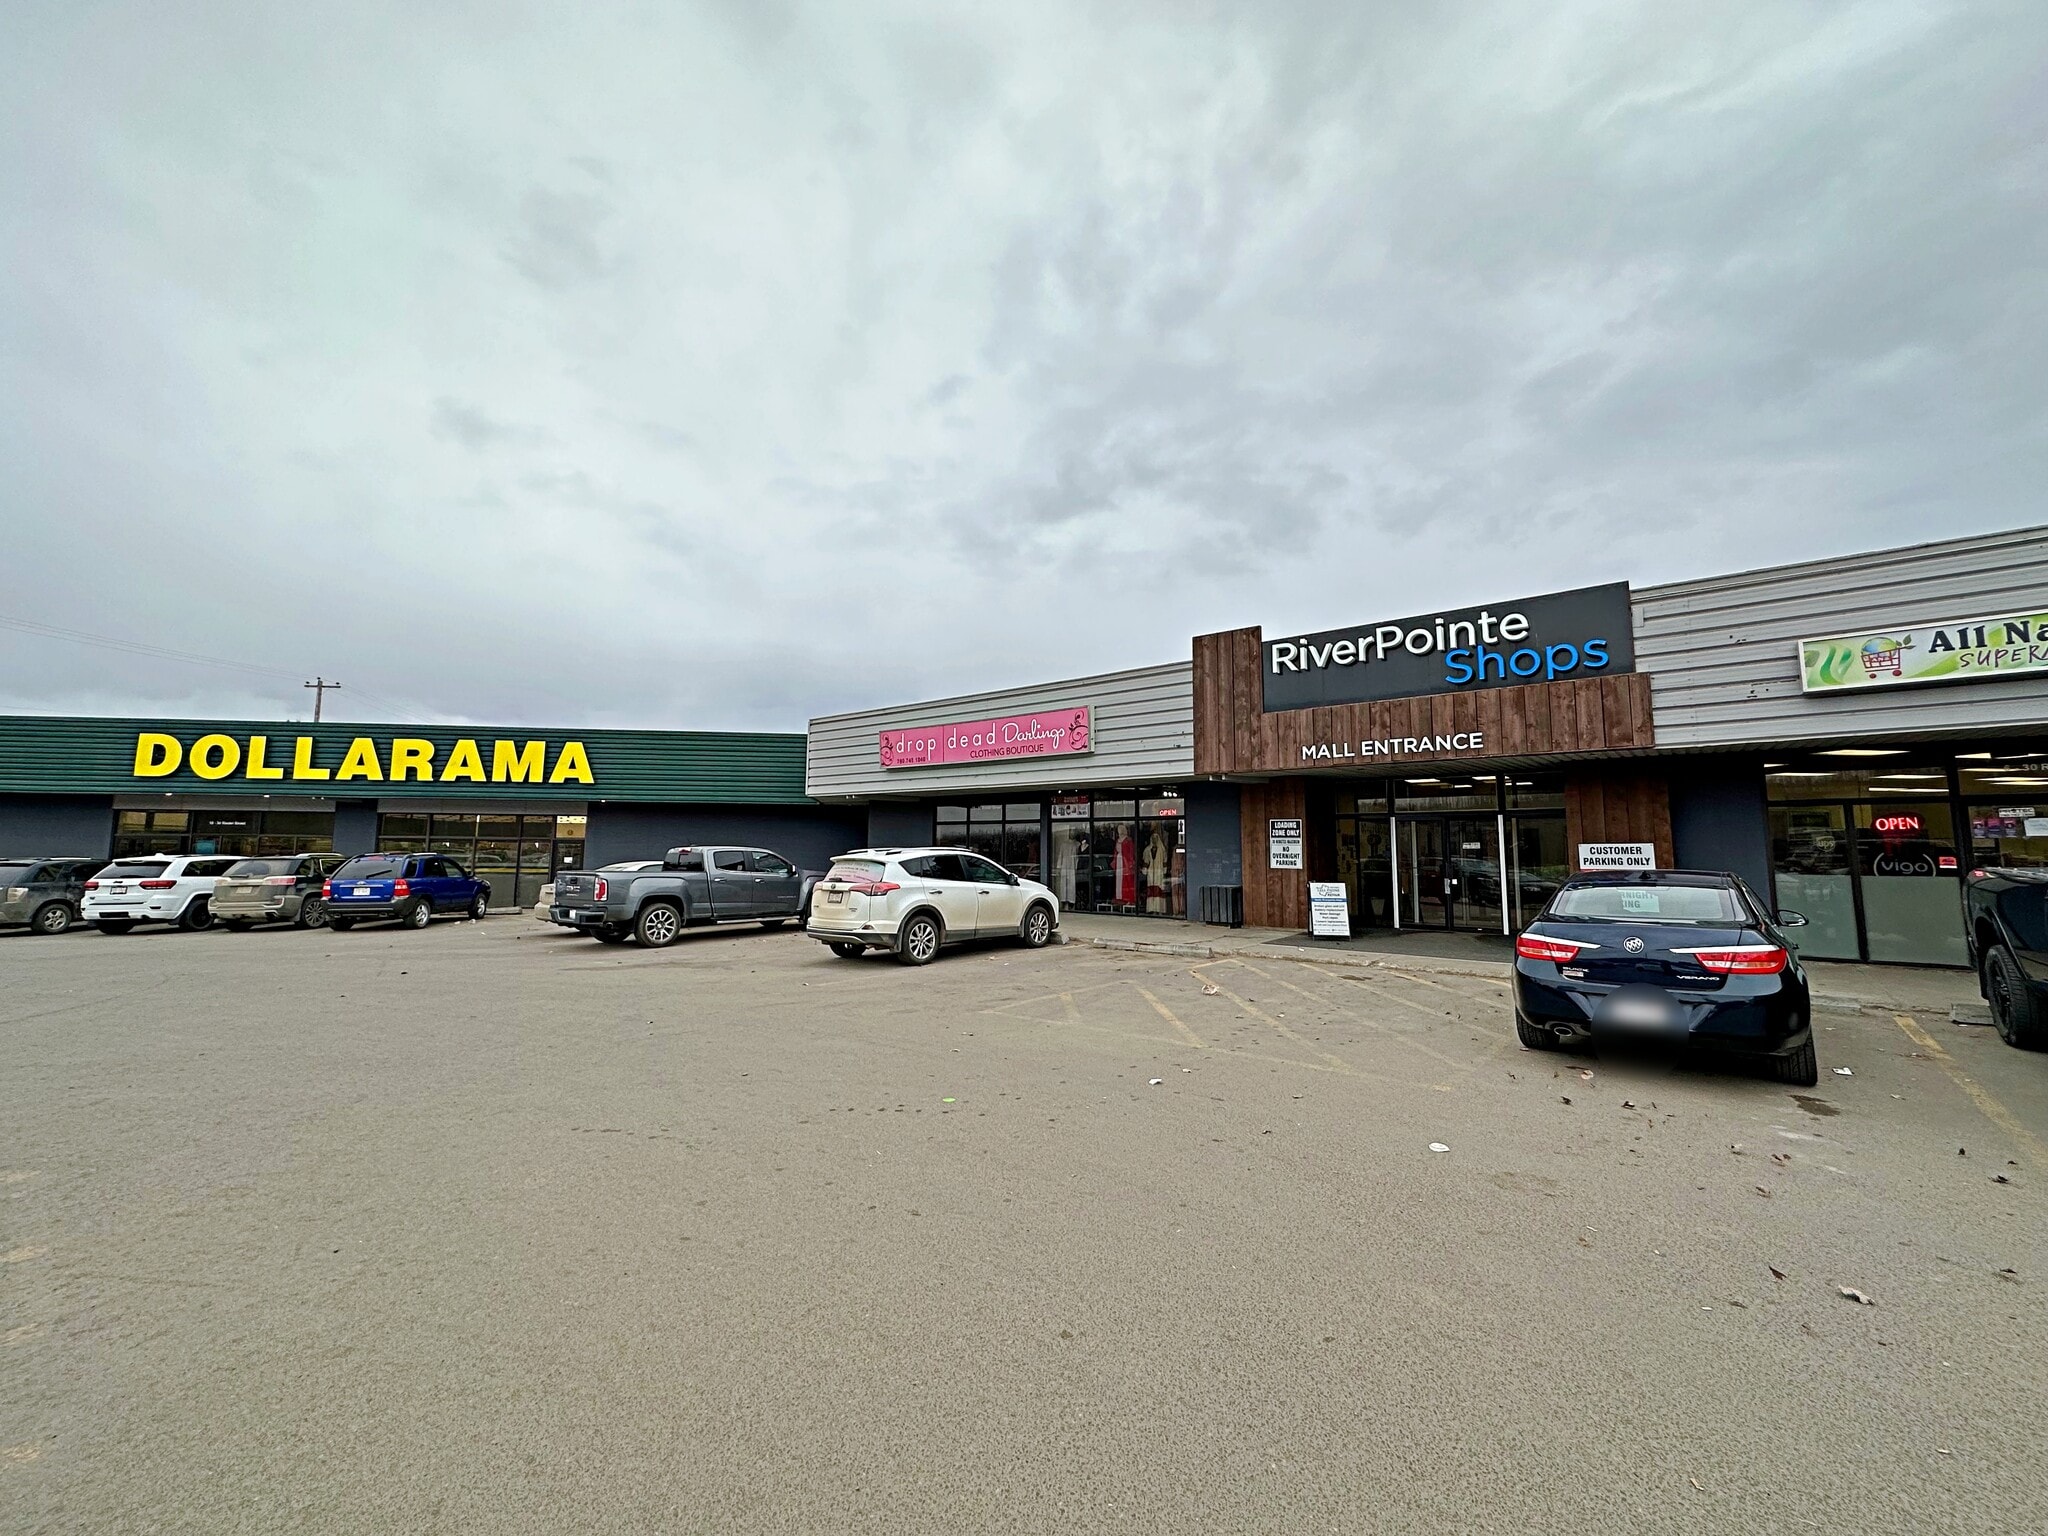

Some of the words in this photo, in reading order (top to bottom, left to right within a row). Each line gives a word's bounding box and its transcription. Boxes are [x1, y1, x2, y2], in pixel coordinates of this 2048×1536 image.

[1271, 610, 1530, 674] RiverPointe
[1928, 625, 1988, 653] All
[1444, 638, 1610, 684] Shops
[896, 733, 937, 761] drop
[947, 723, 996, 749] dead
[1001, 719, 1066, 749] Darlings
[1301, 743, 1355, 760] MALL
[1361, 732, 1485, 756] ENTRANCE
[133, 733, 595, 784] DOLLARAMA
[970, 747, 1005, 759] CLOTHING
[1006, 744, 1044, 756] BOUTIQUE
[2022, 763, 2038, 771] 30
[1274, 821, 1297, 829] LOADING
[1875, 816, 1919, 831] OPEN
[1589, 846, 1643, 855] CUSTOMER
[1583, 857, 1624, 866] PARKING
[1626, 857, 1651, 866] ONLY
